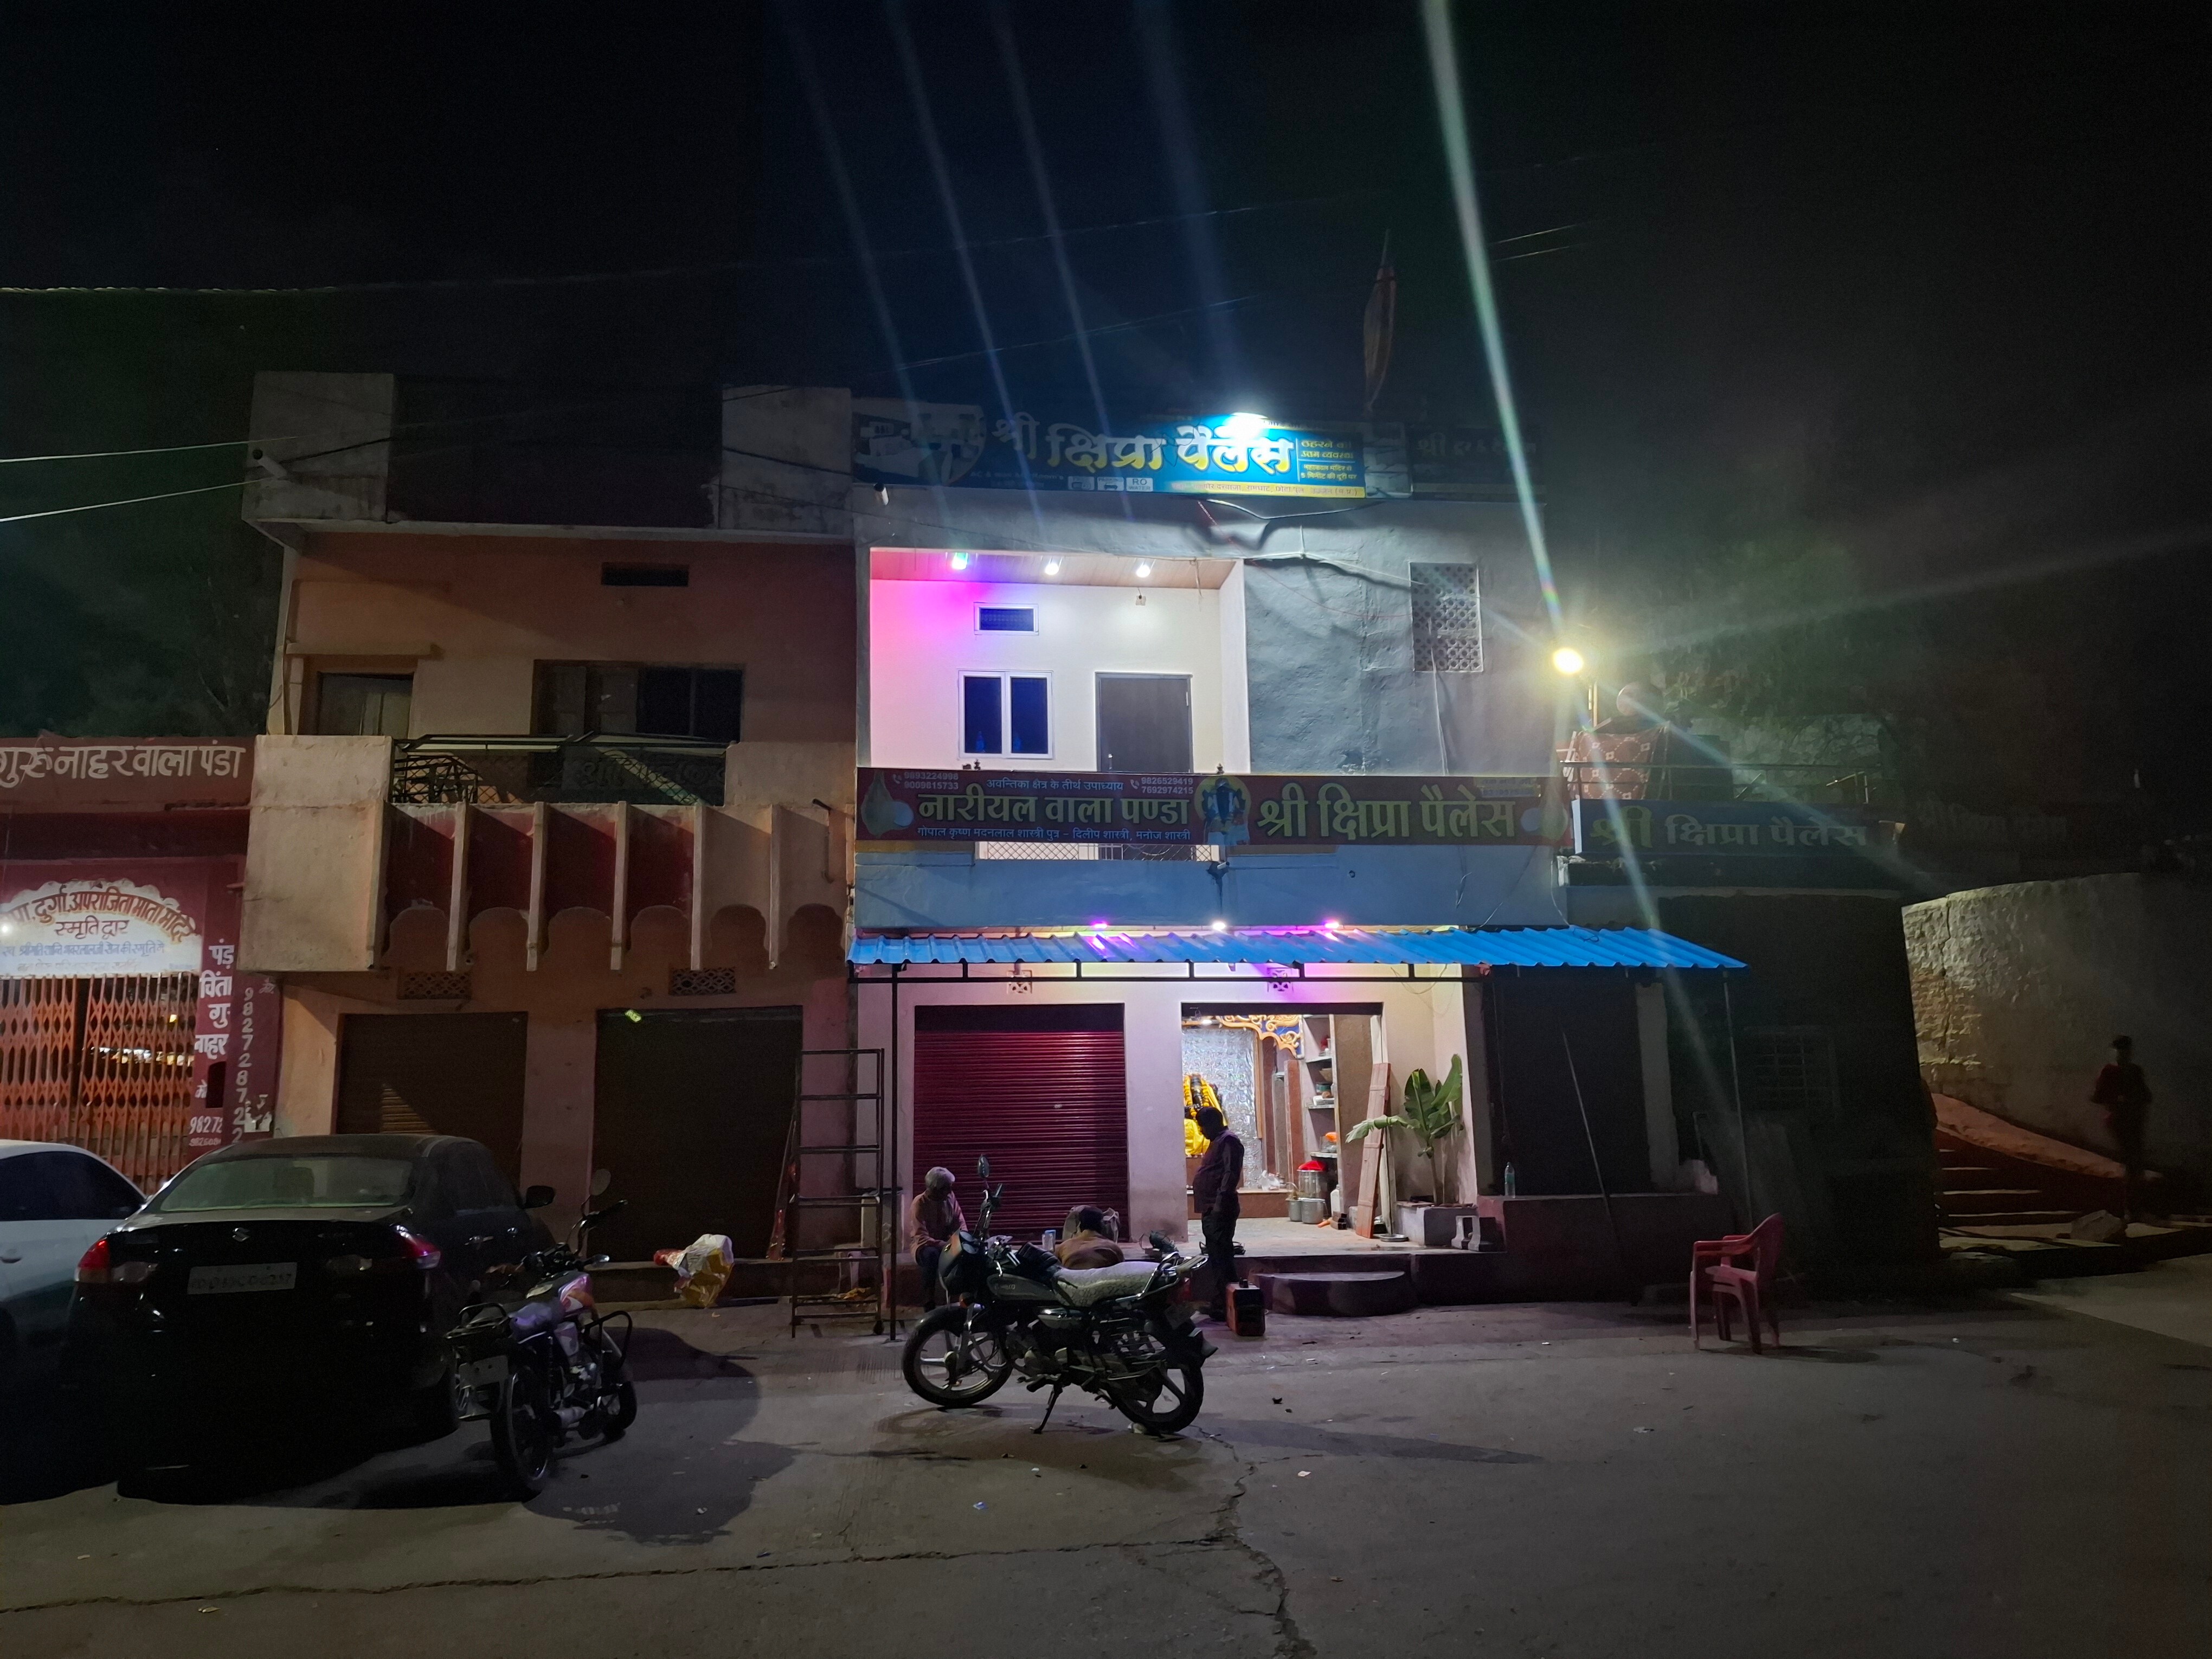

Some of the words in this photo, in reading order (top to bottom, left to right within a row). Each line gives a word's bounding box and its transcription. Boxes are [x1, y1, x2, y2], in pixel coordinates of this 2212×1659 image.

[991, 411, 1041, 460] श्री
[1045, 422, 1167, 473] क्षिप्रा
[1175, 422, 1295, 474] पैलेस
[199, 740, 246, 779] पंडा
[986, 777, 1030, 789] अवन्तिका
[1032, 777, 1047, 790] क्षेत्र
[1050, 778, 1059, 789] के
[1062, 778, 1081, 790] तीर्थ
[1084, 781, 1124, 791] उपाध्याय
[1141, 786, 1193, 795] 7692974215
[918, 782, 1038, 822] नारीयल
[1045, 796, 1113, 824] वाला
[1120, 798, 1190, 825] पण्डा
[1257, 783, 1308, 837] श्री
[1317, 783, 1411, 840] क्षिप्रा
[1419, 783, 1515, 838] पैलेस
[917, 826, 947, 837] गोपाल
[949, 828, 971, 840] कृष्ण
[974, 828, 1014, 838] मदनलाल
[1018, 827, 1044, 839] शास्त्री
[1046, 829, 1060, 841] पुत्र
[1073, 828, 1100, 839] दिलीप
[1136, 828, 1162, 840] मनोज
[1165, 829, 1191, 841] शास्त्री
[1590, 805, 1654, 848] श्री
[1664, 814, 1759, 846] क्षिप्रा
[1769, 815, 1868, 846] पैलेस
[131, 896, 161, 922] माता
[55, 915, 99, 939] स्मृति
[101, 919, 130, 940] द्वार
[120, 941, 131, 954] की
[132, 940, 156, 957] स्मृति
